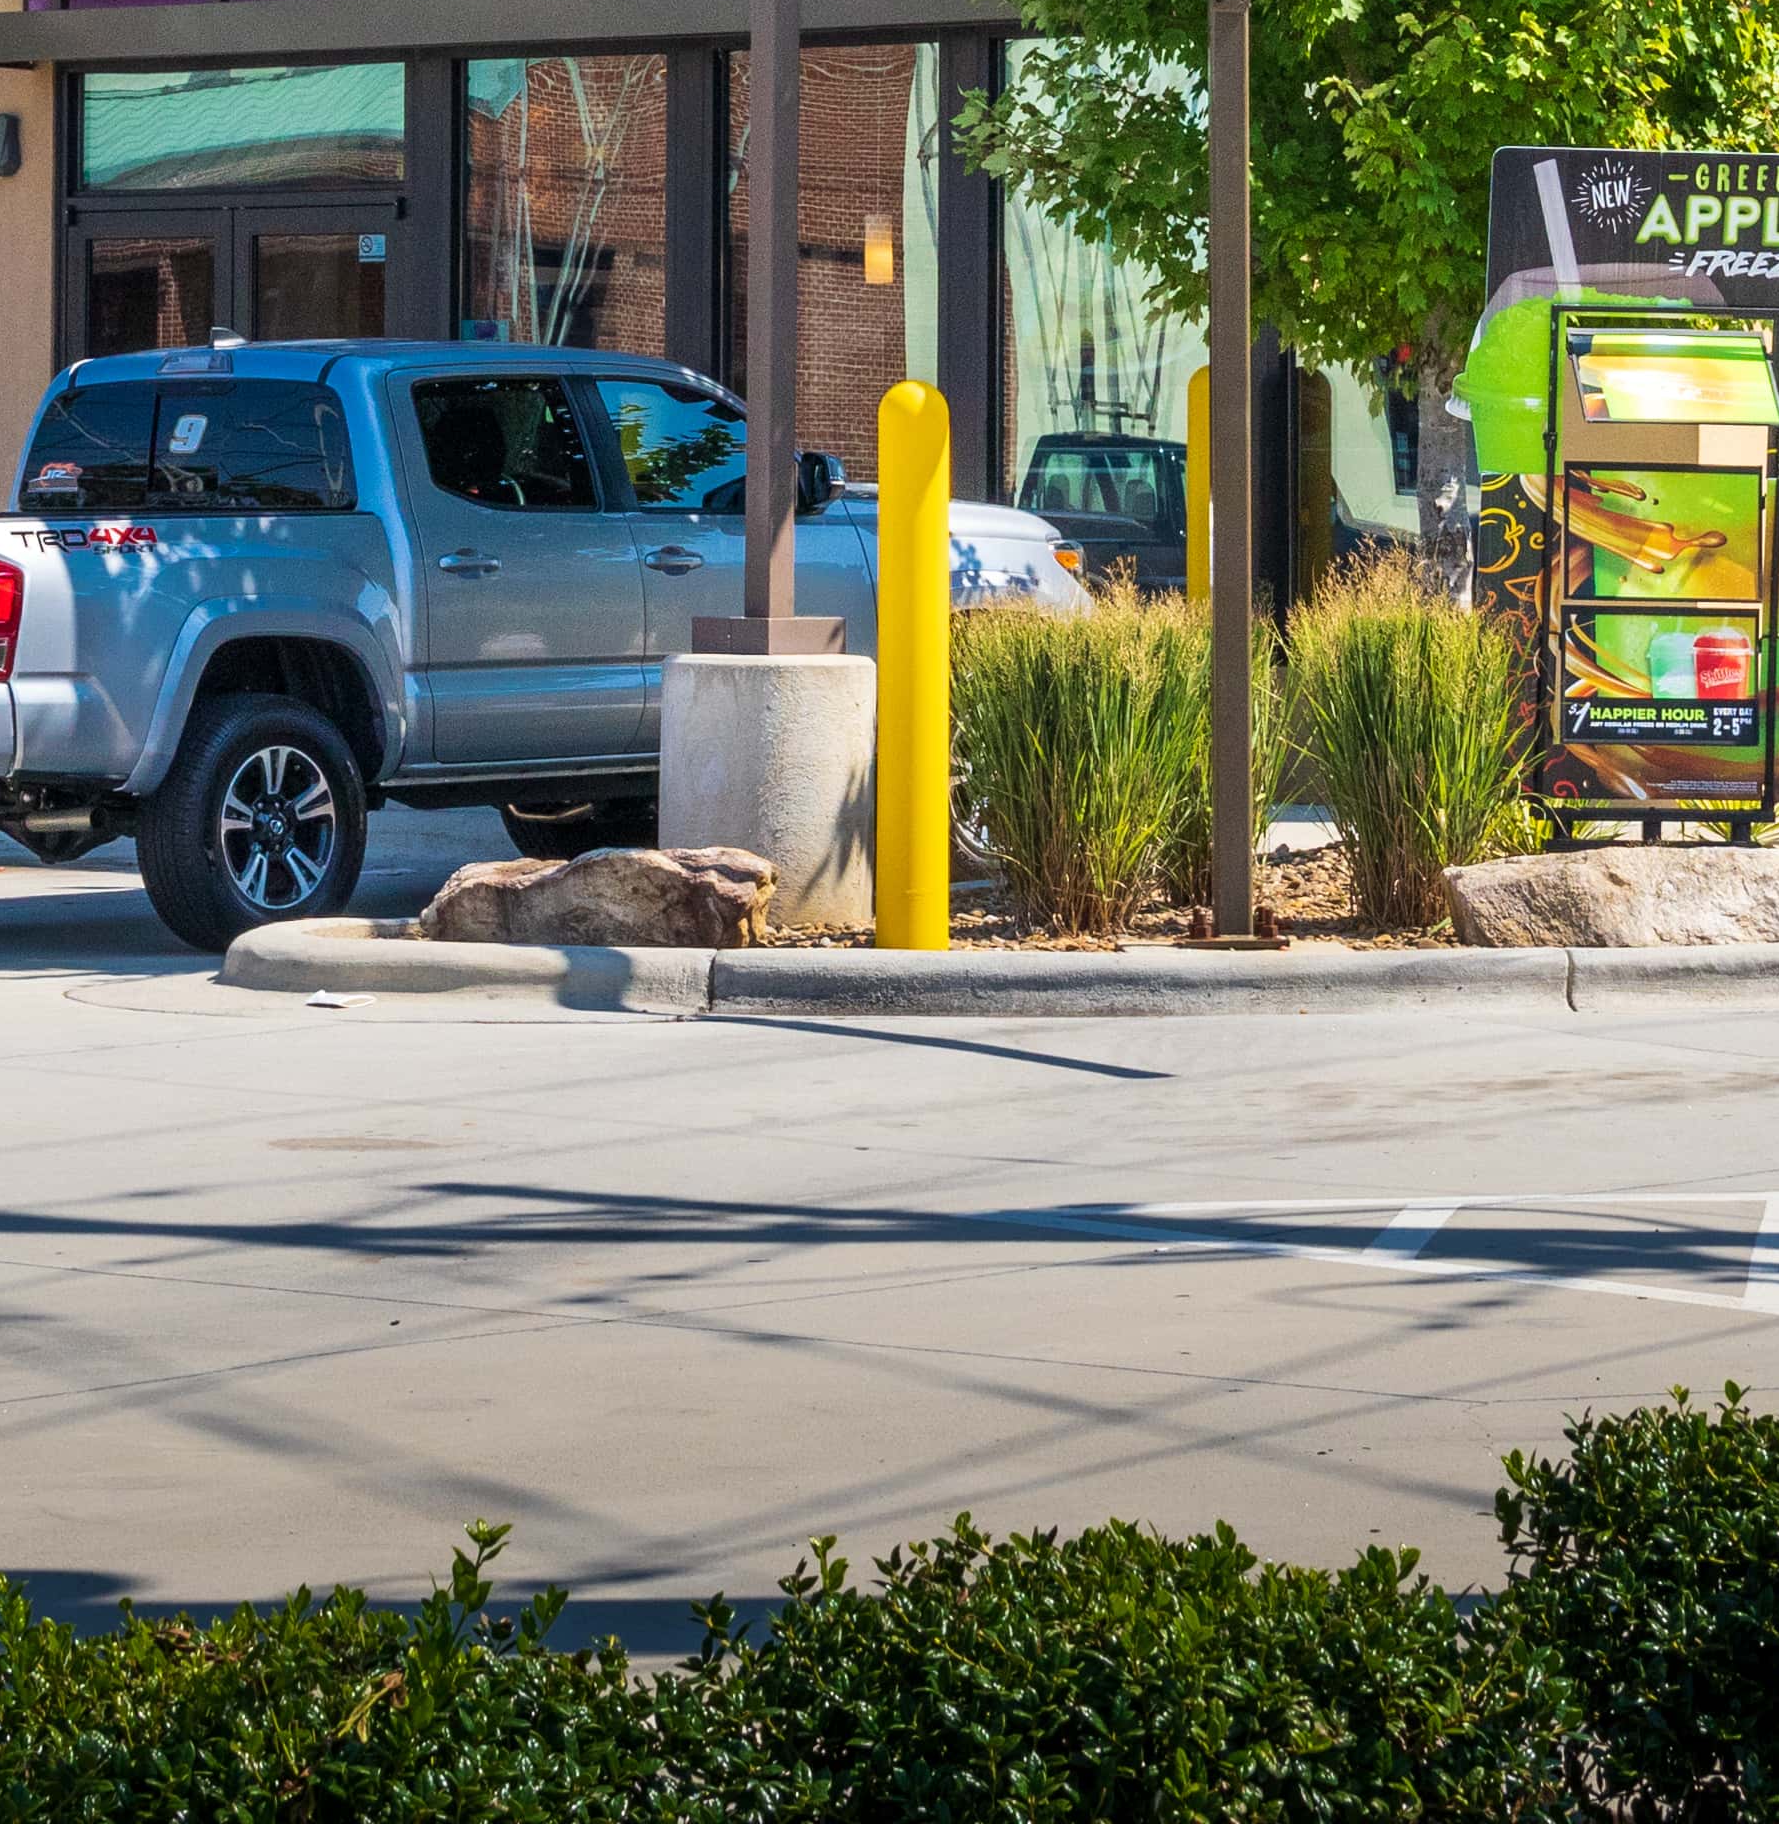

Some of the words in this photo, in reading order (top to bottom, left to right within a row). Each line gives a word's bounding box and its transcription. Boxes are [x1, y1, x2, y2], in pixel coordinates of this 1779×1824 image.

[1592, 176, 1632, 209] NEW
[169, 414, 208, 454] 9
[10, 529, 89, 554] TRD
[92, 544, 154, 556] SPORT
[1590, 707, 1656, 720] HAPPIER
